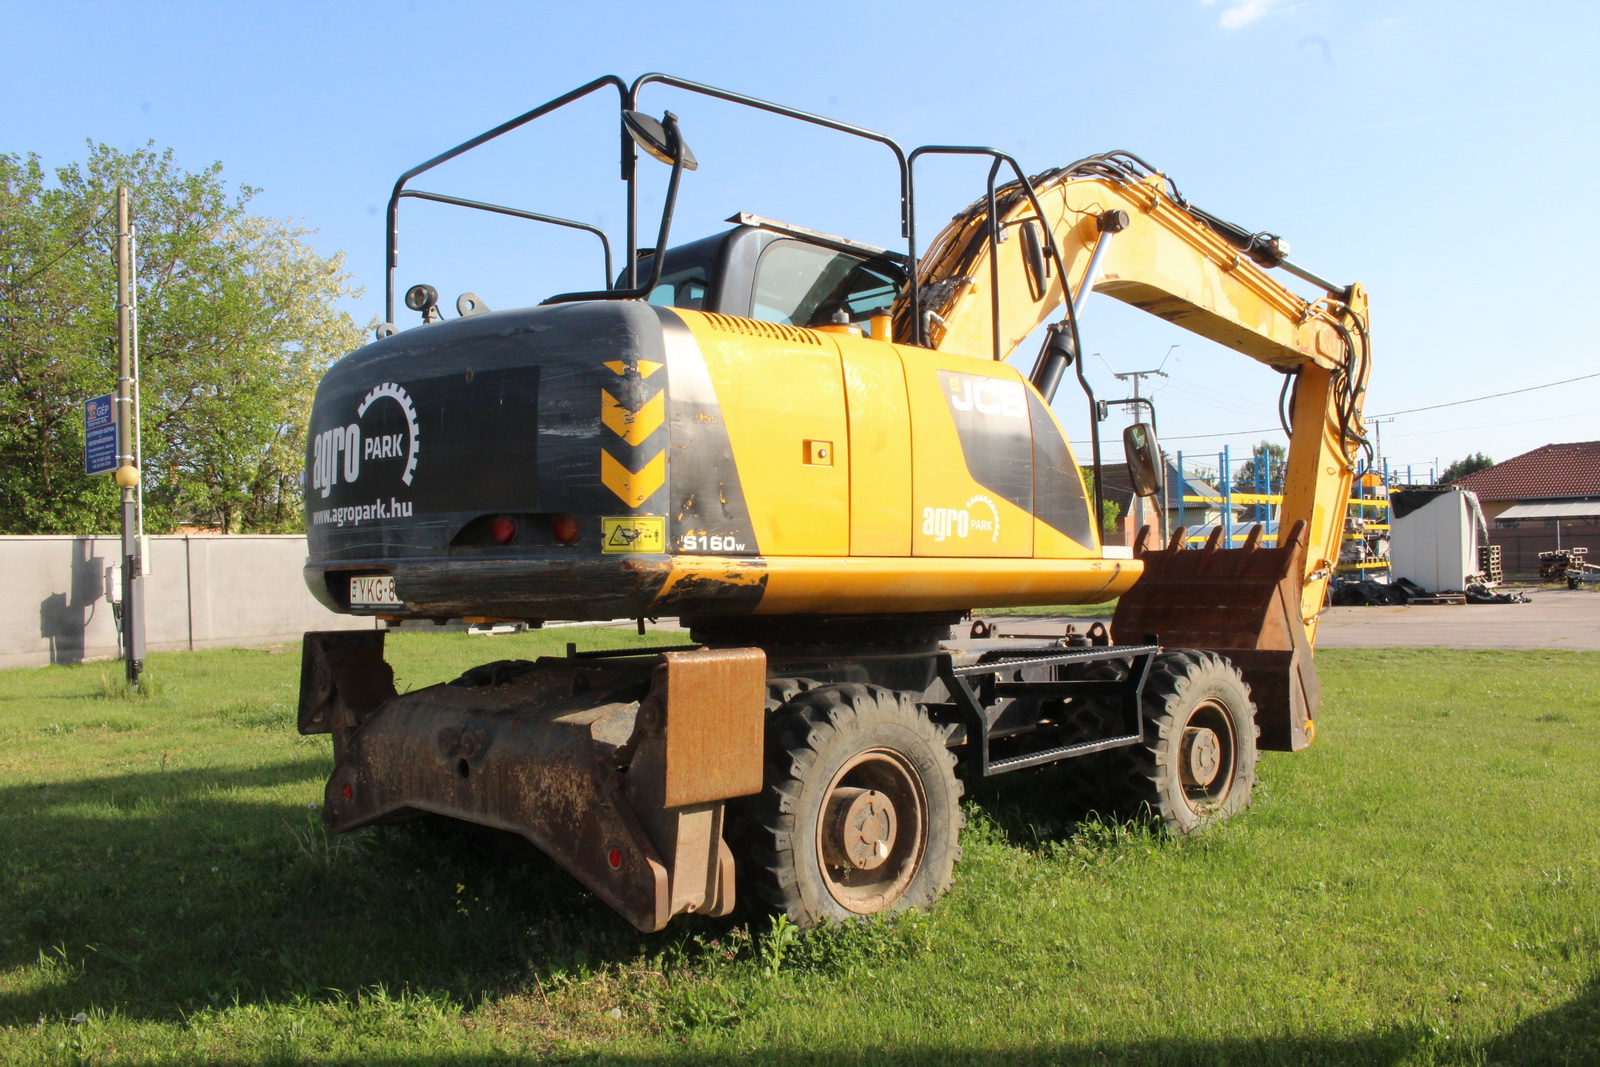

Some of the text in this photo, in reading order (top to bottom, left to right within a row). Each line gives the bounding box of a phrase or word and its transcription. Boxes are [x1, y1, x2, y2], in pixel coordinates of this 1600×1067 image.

[97, 403, 109, 416] GÉP
[951, 380, 1027, 418] JCB
[313, 423, 404, 499] agro PARK
[312, 497, 413, 527] www.agropark.hu
[922, 506, 993, 542] agro PARK
[359, 578, 401, 602] YKG-8
